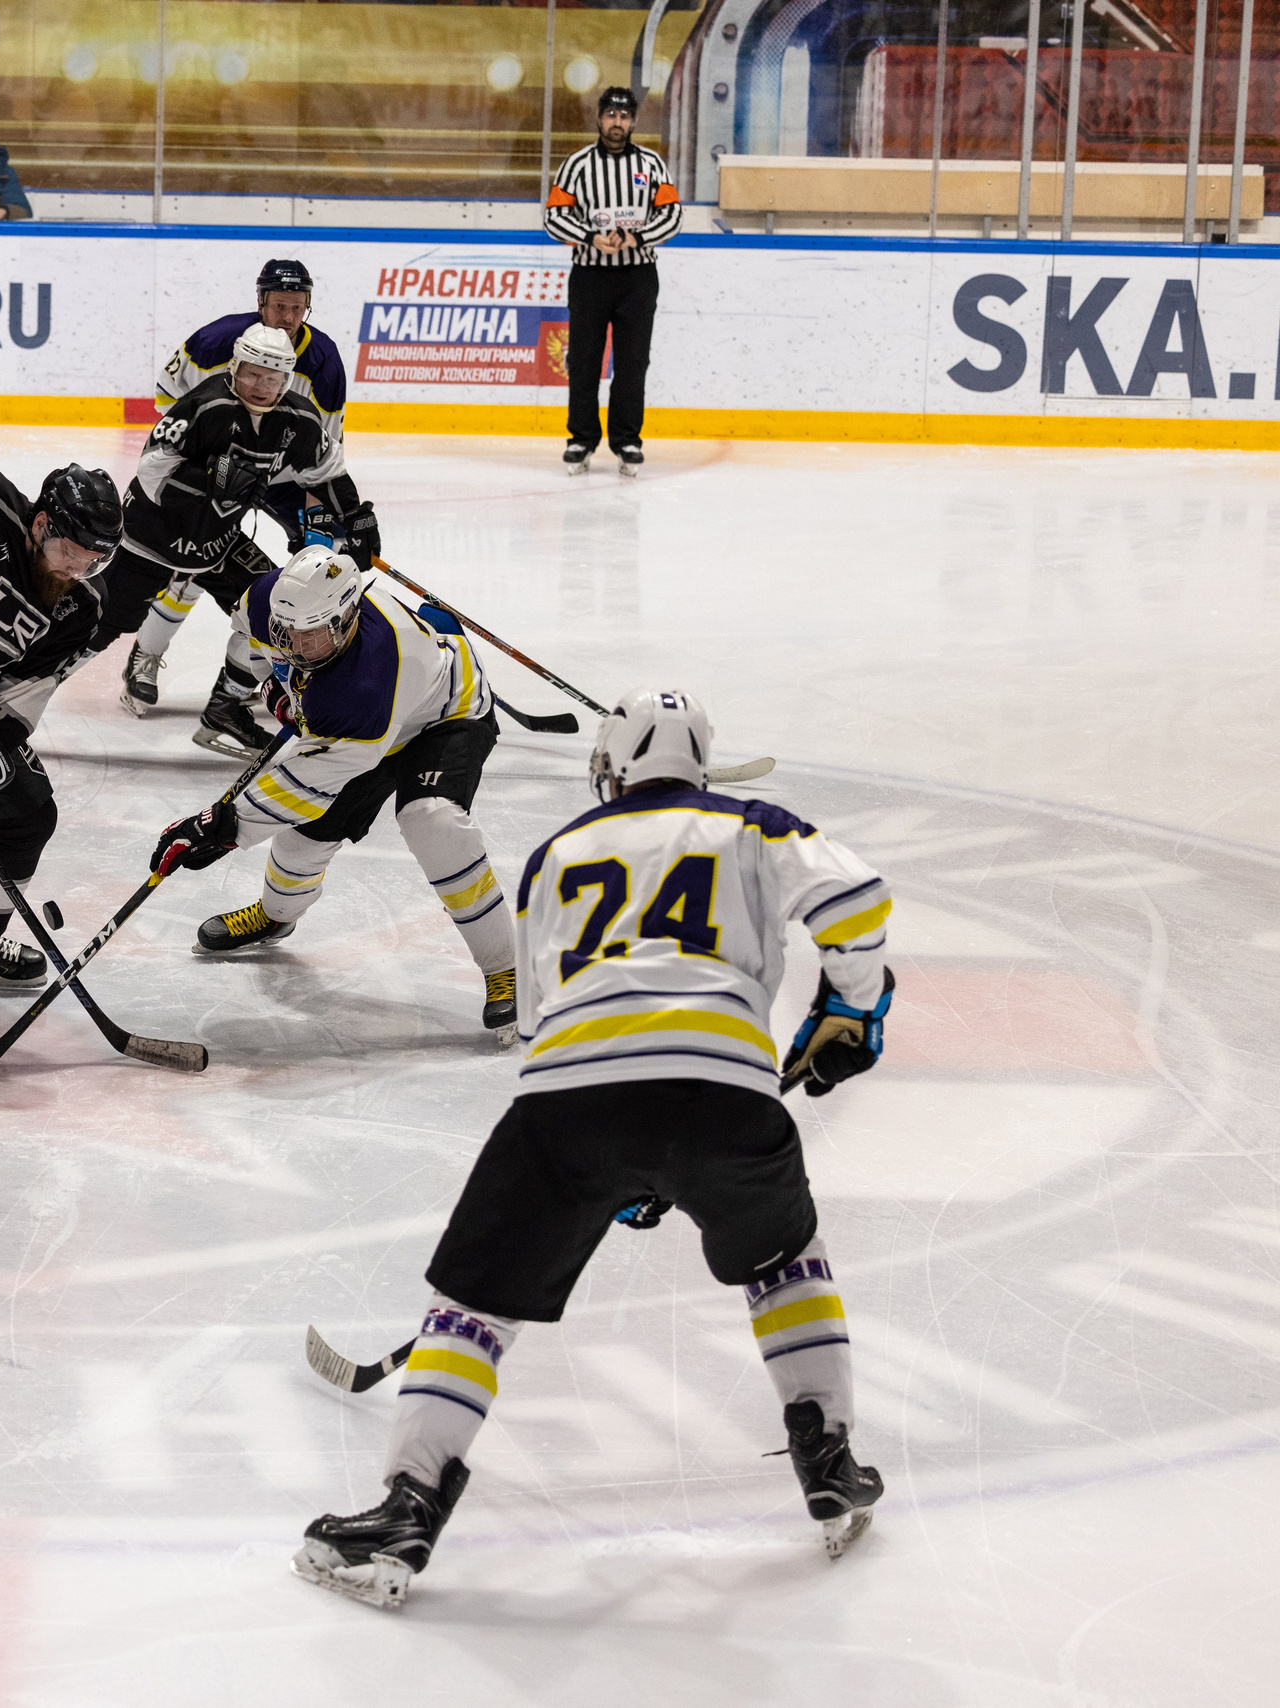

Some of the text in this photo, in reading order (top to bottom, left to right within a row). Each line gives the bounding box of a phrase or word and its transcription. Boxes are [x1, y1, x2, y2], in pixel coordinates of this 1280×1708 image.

[376, 268, 520, 298] КРАСНАЯ
[368, 305, 518, 343] МАШИНА
[947, 273, 1280, 400] SKA.
[368, 345, 535, 363] НАЦИОНАЛЬНАЯ ПРОГРАММА
[364, 365, 517, 382] ПОДГОТОВКИ ХОККЕИСТОВ
[153, 416, 188, 444] 68
[231, 760, 261, 797] TACKS
[57, 918, 118, 989] CCM
